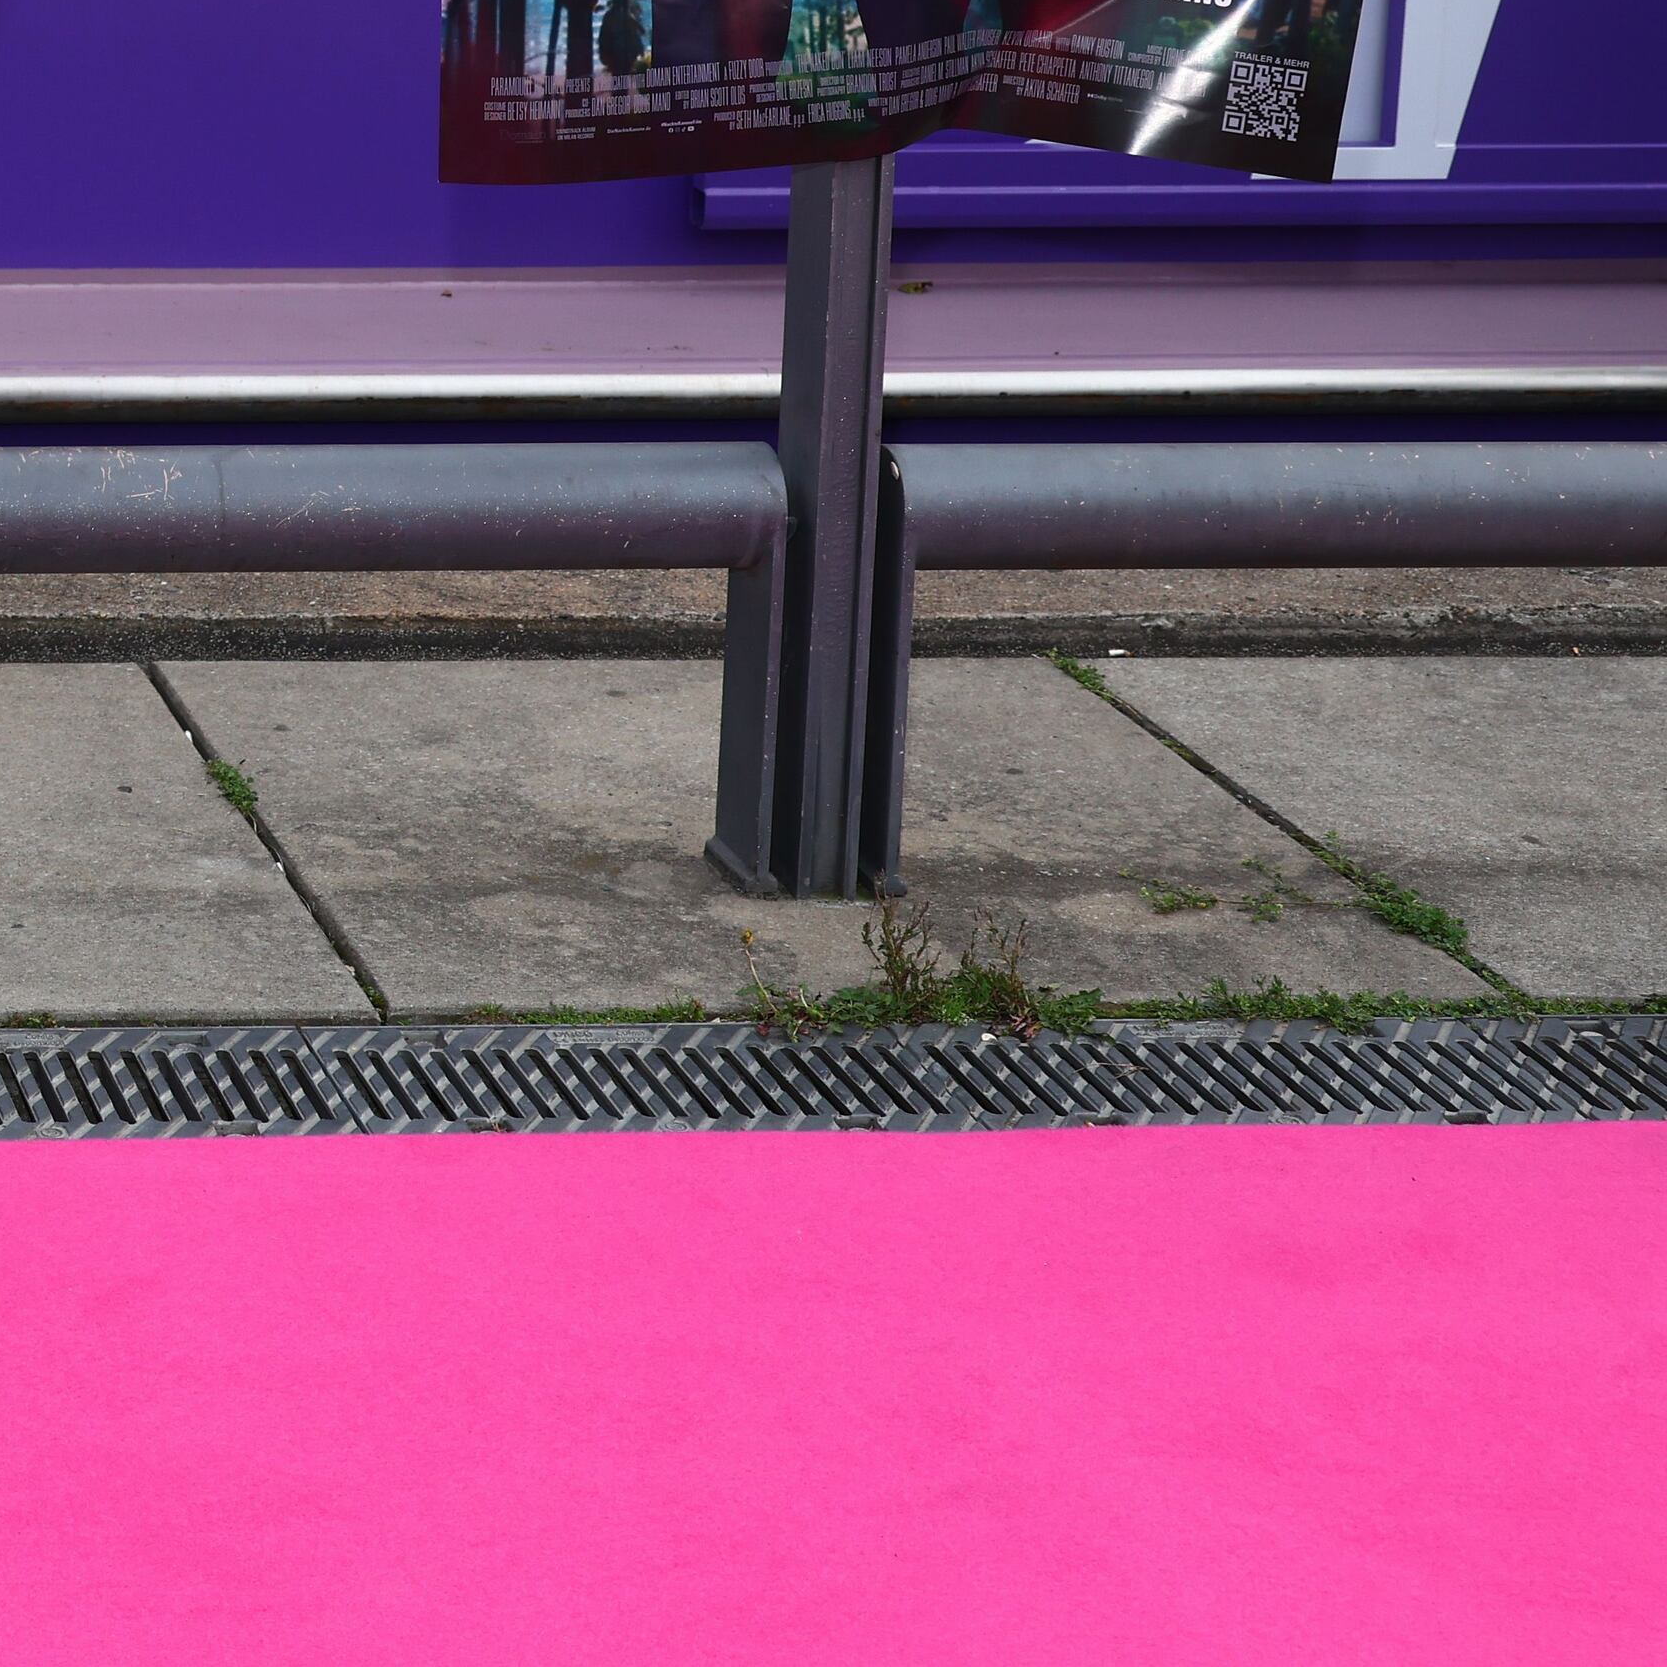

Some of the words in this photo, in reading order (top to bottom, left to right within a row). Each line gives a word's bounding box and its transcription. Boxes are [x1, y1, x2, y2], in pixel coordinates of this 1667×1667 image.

[646, 67, 671, 88] DOMAIN
[672, 62, 720, 86] ENTERTAINMENT
[728, 59, 747, 80] FUZZY
[867, 46, 892, 68] NEESON
[895, 43, 916, 65] PAMELA
[1070, 34, 1096, 56] DANNY
[1095, 38, 1125, 60] HUSTON
[1019, 52, 1036, 73] PETE
[1036, 54, 1076, 78] CHIAPPETTA
[1078, 60, 1114, 84] ANTHONY
[1113, 65, 1155, 90] TITTANEGRO
[1234, 51, 1274, 64] TRAILER
[1274, 57, 1281, 65] &
[1283, 58, 1310, 69] MEHR
[845, 73, 877, 94] BRANDON
[879, 71, 897, 92] TROST
[1024, 78, 1045, 100] AKIVA
[1046, 81, 1080, 105] SCHAFFER
[592, 97, 605, 117] DAN
[606, 95, 631, 116] GREGOR
[651, 92, 671, 112] MAND
[690, 87, 709, 109] BRIAN
[710, 86, 729, 107] SCOTT
[507, 101, 528, 121] BETSY
[736, 109, 752, 130] SETH
[807, 102, 825, 123] ERICA
